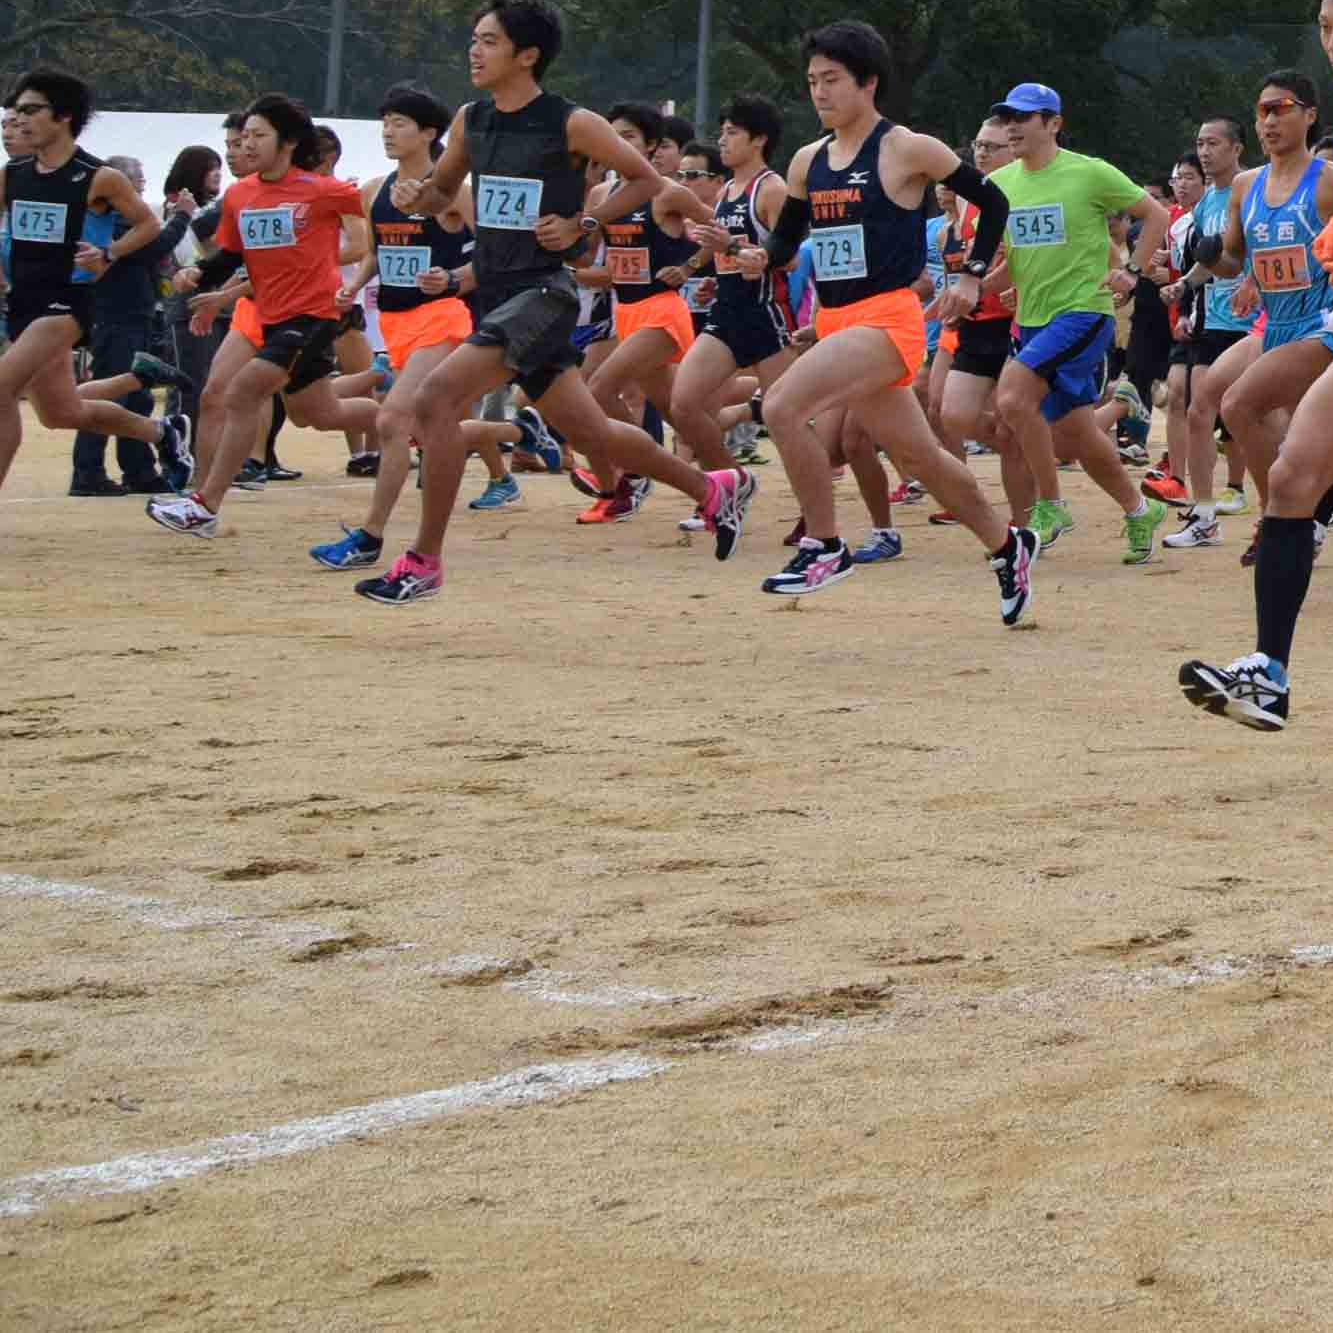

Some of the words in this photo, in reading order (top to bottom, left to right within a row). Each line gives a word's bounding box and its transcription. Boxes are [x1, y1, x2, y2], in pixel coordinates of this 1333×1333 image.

[485, 189, 527, 217] 724
[18, 212, 57, 233] 475
[247, 218, 284, 240] 678
[1016, 215, 1056, 237] 545
[1253, 221, 1295, 243] 名西
[815, 239, 853, 267] 729
[385, 256, 420, 277] 720
[1257, 257, 1295, 283] 781
